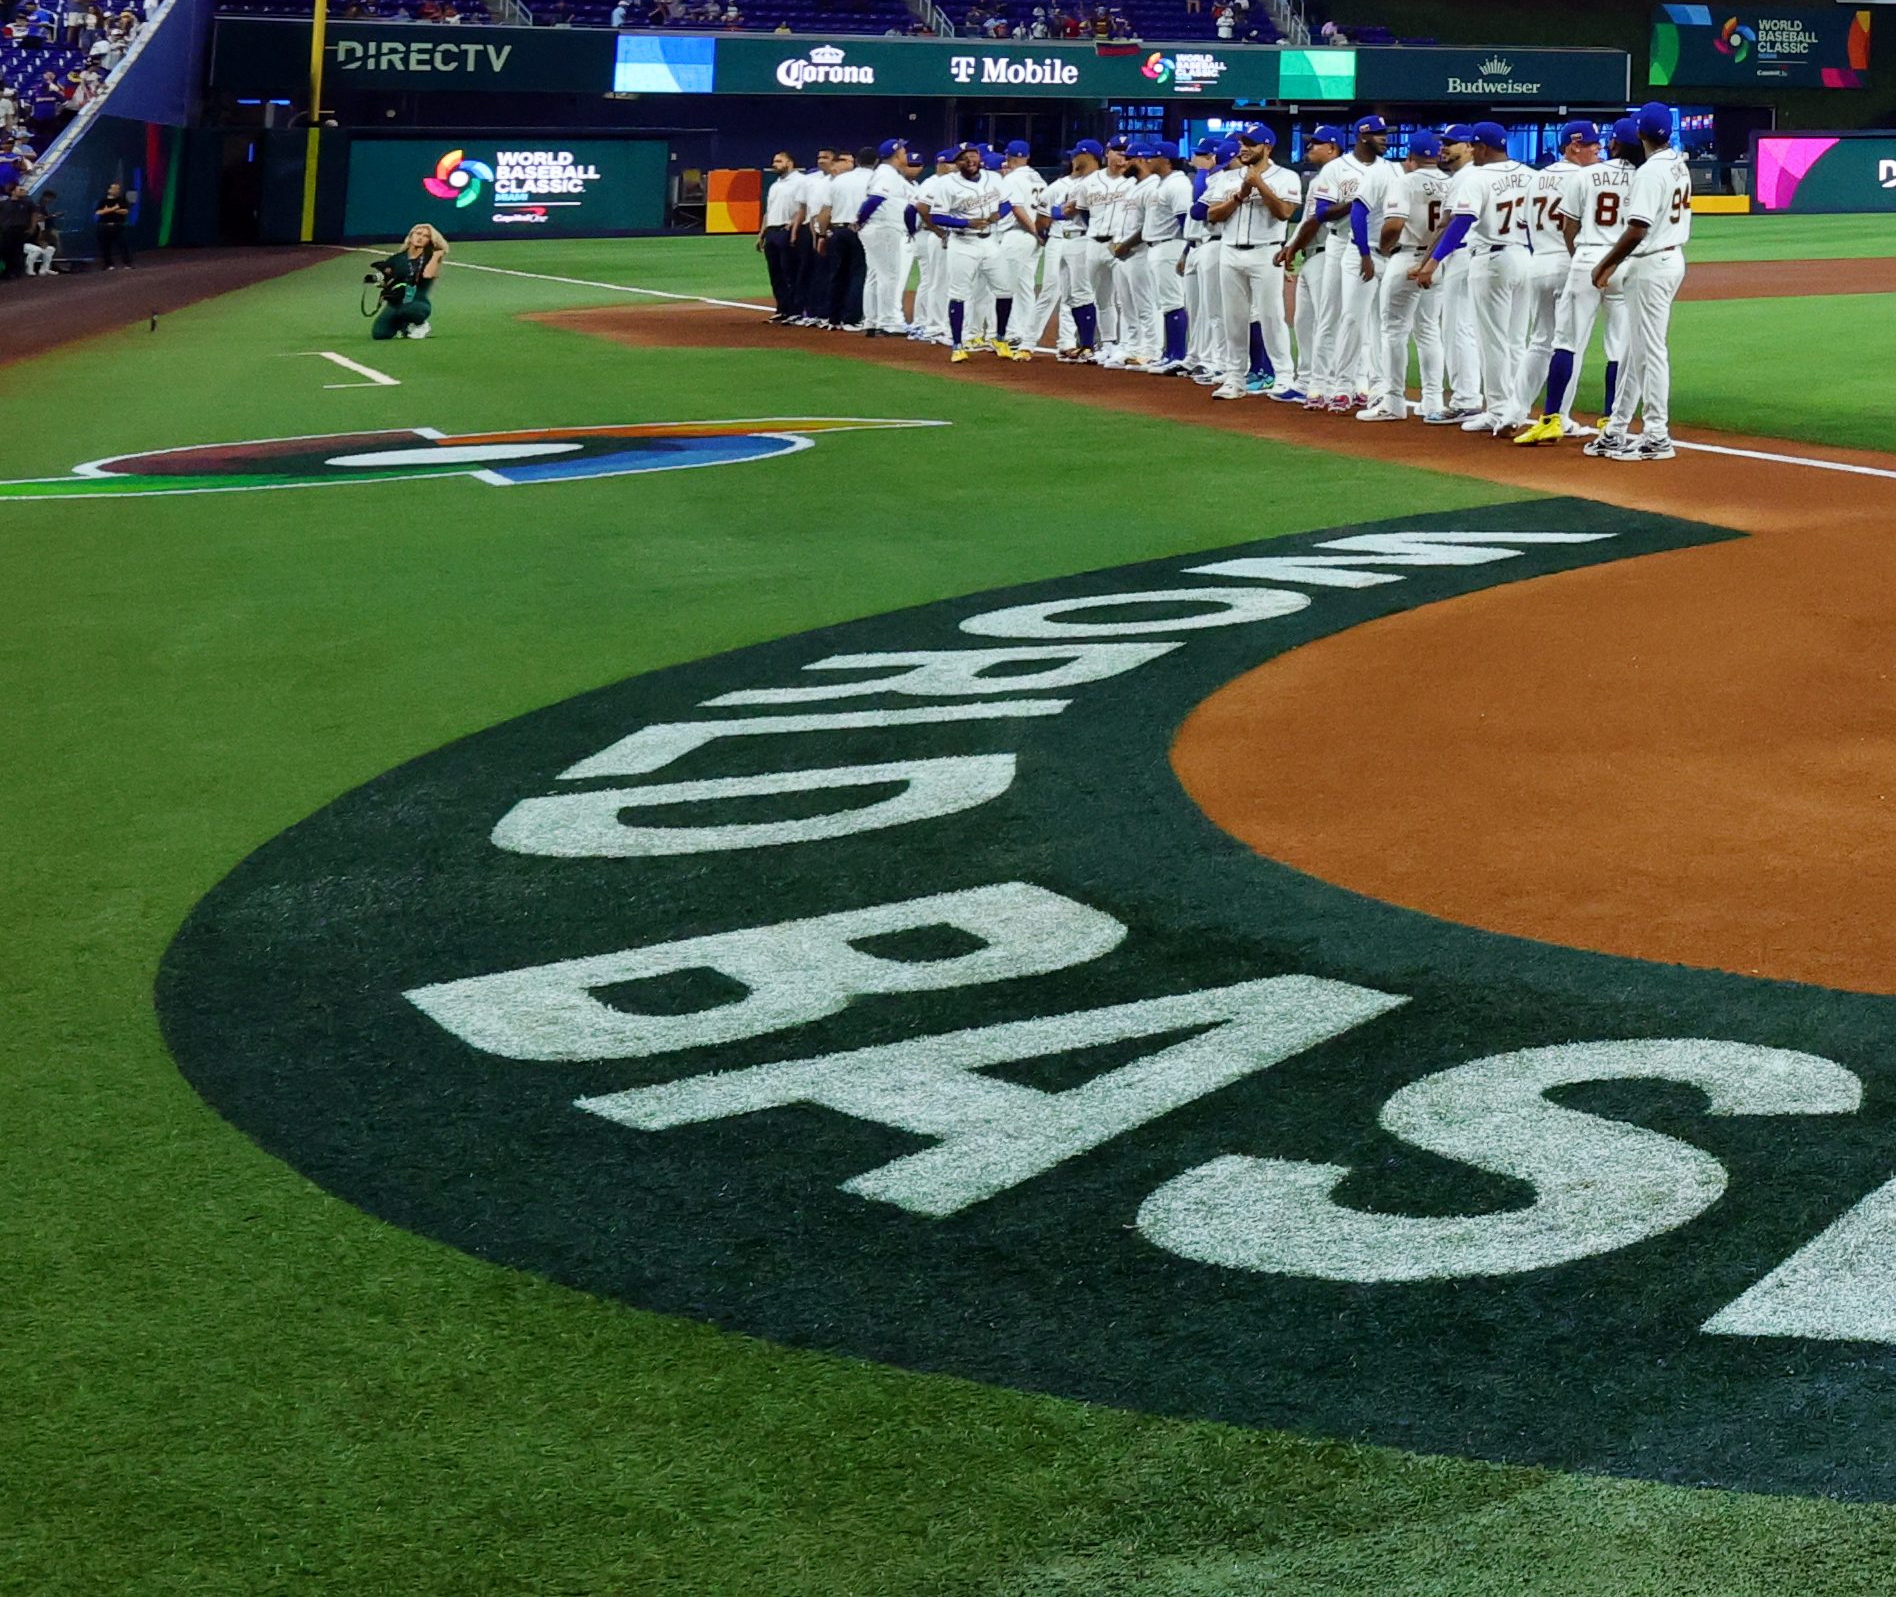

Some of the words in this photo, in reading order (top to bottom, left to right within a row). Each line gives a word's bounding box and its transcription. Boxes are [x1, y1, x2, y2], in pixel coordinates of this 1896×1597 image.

[1758, 19, 1802, 31] WORLD
[1758, 31, 1818, 43] BASEBALL
[1757, 42, 1809, 53] CLASSIC
[337, 41, 512, 73] DIRECTV
[776, 58, 875, 89] Corona
[981, 57, 1079, 84] Mobile
[1447, 77, 1541, 94] Budweiser
[496, 152, 574, 166] WORLD
[496, 165, 600, 180] BASEBALL
[1591, 171, 1630, 188] BAZA
[1533, 196, 1565, 232] 74
[490, 530, 1619, 860] WORLD
